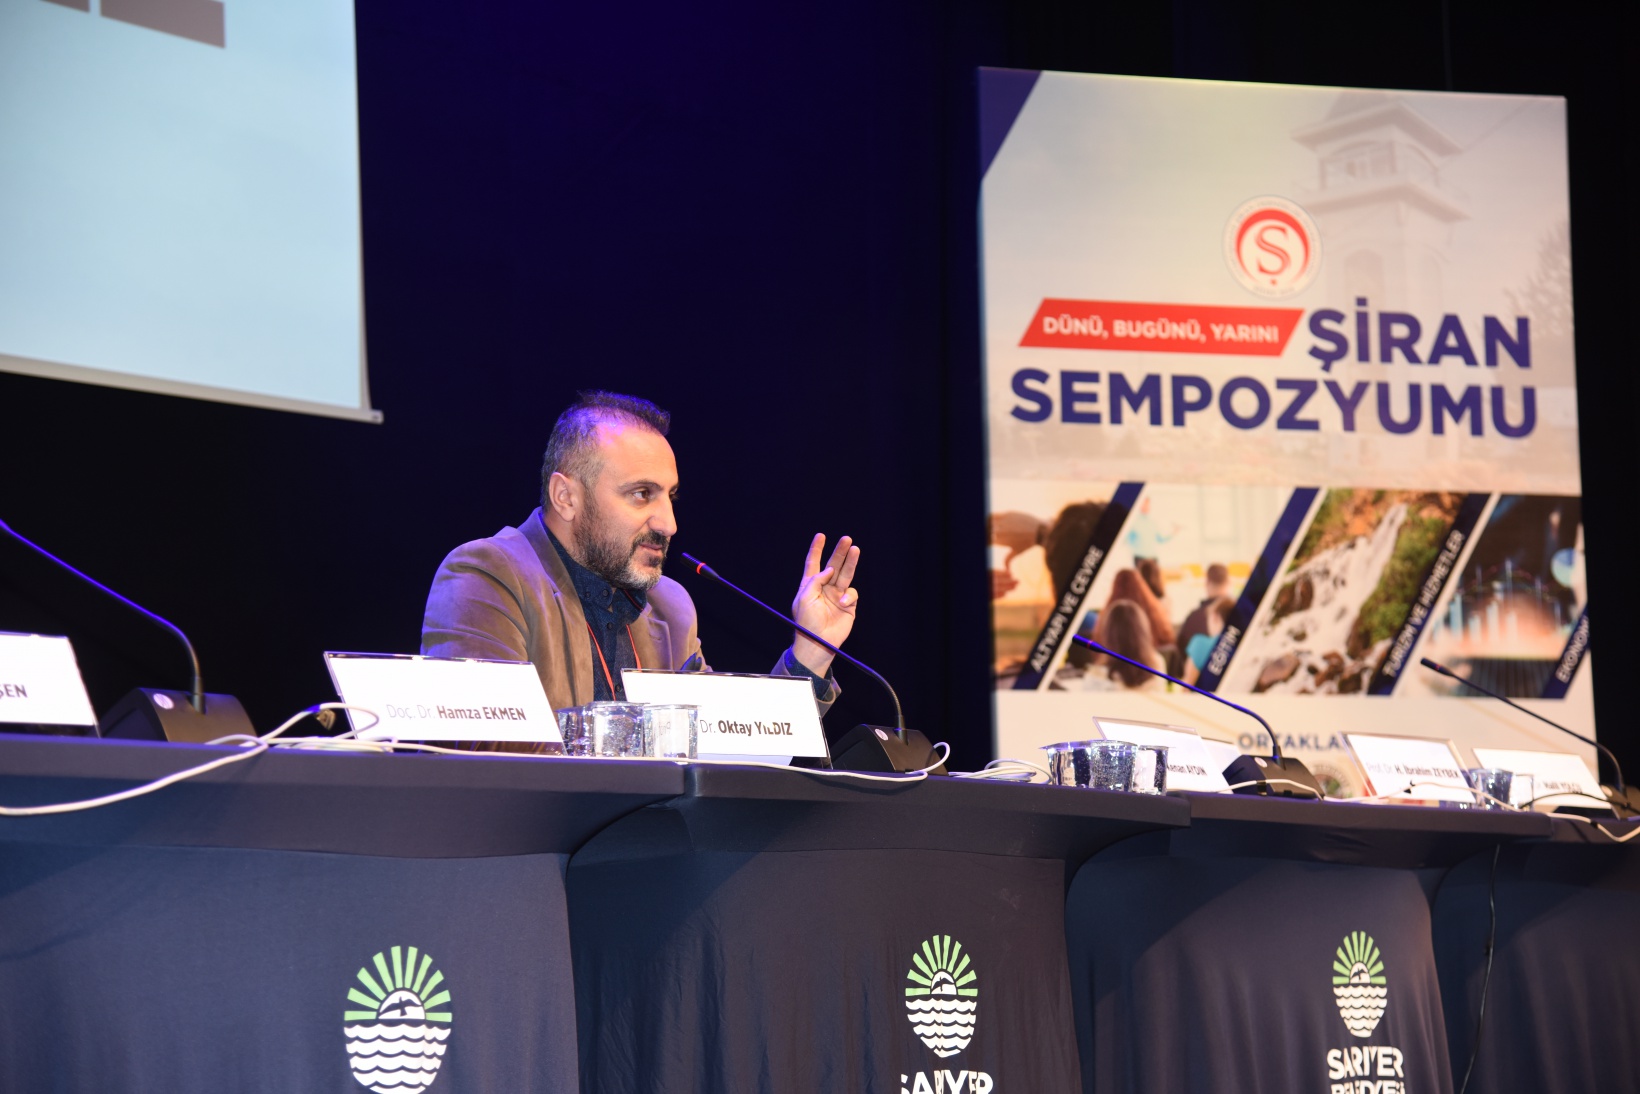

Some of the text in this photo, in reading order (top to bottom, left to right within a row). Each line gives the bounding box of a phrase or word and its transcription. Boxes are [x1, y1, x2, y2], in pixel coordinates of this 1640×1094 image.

[1042, 313, 1279, 344] DÜNÜ, BUGÜNÜ, YARINI
[1307, 296, 1531, 372] ŞİRAN
[1010, 368, 1537, 438] SEMPOZYUMU
[1030, 615, 1067, 673] ALTYAPI
[1060, 594, 1079, 618] VE
[417, 704, 435, 720] Dr.
[436, 705, 482, 720] Hamza
[483, 706, 527, 721] EKMEN
[700, 719, 716, 734] Dr.
[718, 719, 752, 737] Oktay
